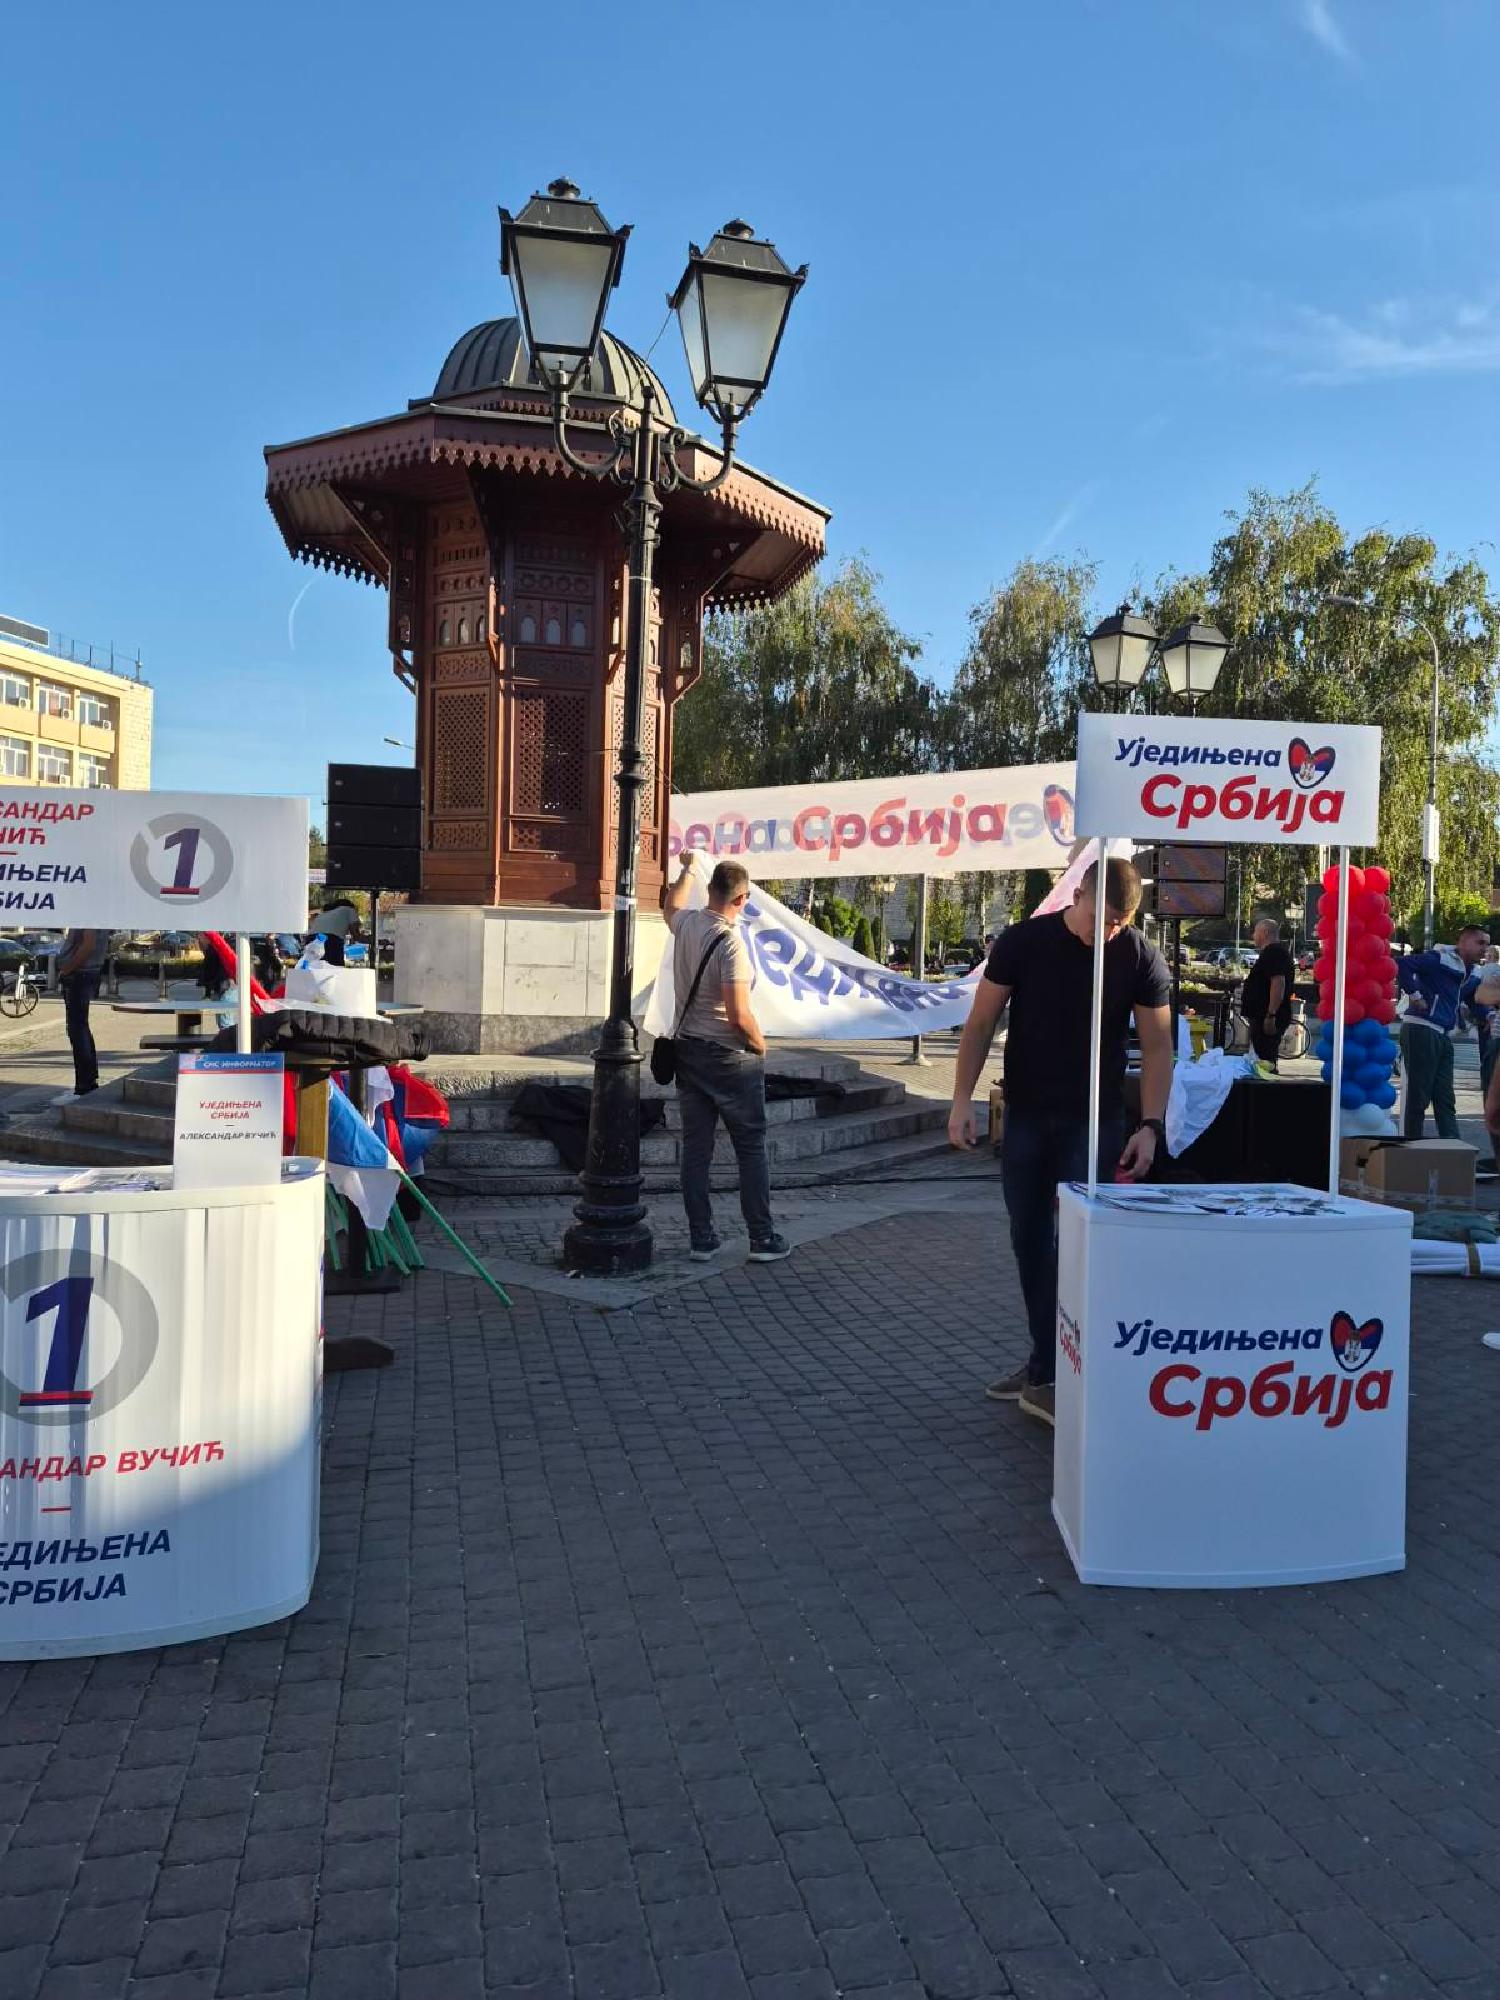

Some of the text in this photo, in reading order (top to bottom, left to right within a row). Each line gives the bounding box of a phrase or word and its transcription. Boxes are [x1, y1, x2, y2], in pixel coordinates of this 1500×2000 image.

[1115, 736, 1281, 767] Уједињена
[1140, 774, 1345, 833] Србија
[795, 794, 1007, 862] Србија
[163, 828, 201, 892] 1
[199, 1100, 262, 1110] УЈЕДИЊЕНА
[210, 1111, 250, 1120] СРБИЈА
[179, 1131, 277, 1141] АЛЕКСАНДАР ВУЧИЋ
[22, 1277, 94, 1398] 1
[1113, 1320, 1324, 1356] Уједињена
[1149, 1360, 1393, 1430] Србија
[116, 1441, 225, 1474] ВУЧИЋ
